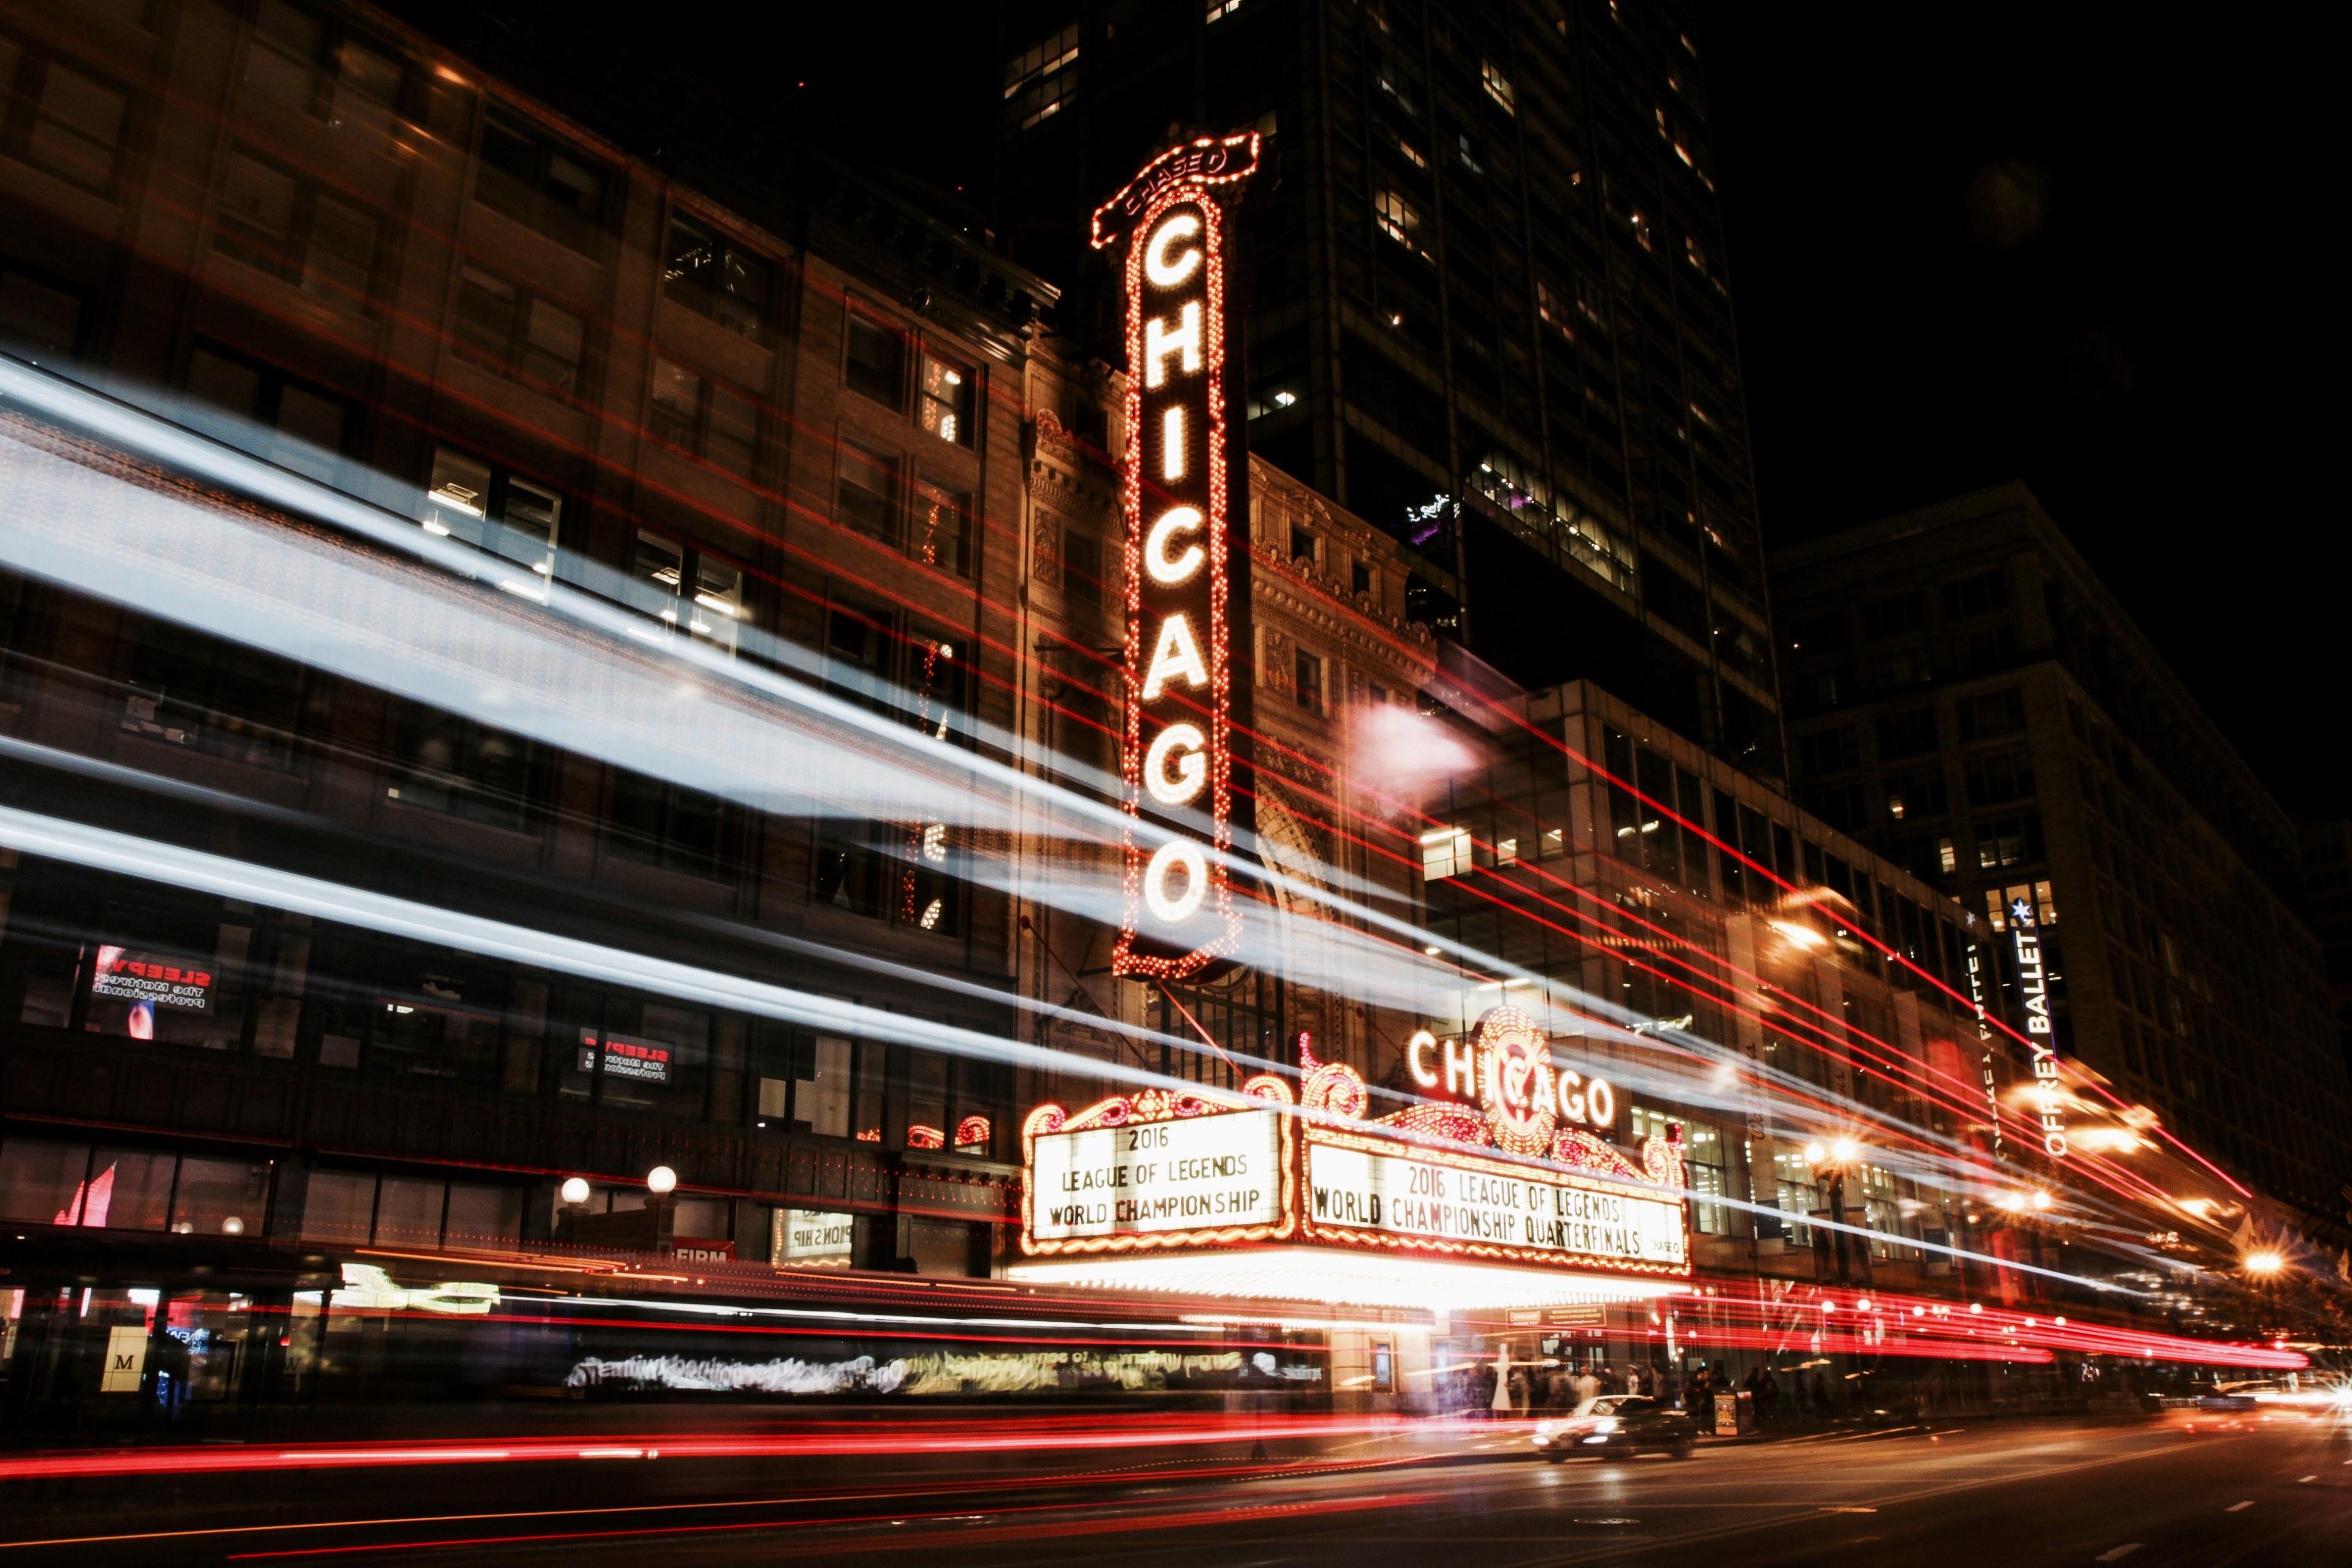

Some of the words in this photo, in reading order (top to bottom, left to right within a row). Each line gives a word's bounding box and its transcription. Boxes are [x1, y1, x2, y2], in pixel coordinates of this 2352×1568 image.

[1142, 214, 1210, 924] CHICAGO
[2015, 930, 2051, 1034] BALLET
[1409, 1030, 1614, 1126] CHICAGO
[1129, 1127, 1169, 1151] 2016
[1062, 1166, 1128, 1191] LEAGUE
[1136, 1163, 1158, 1185] OF
[1169, 1154, 1247, 1181] LEGENDS
[1409, 1166, 1446, 1198] 2016
[1460, 1174, 1520, 1209] LEAGUE
[1529, 1186, 1546, 1212] OF
[1556, 1189, 1619, 1223] LEGENDS
[1050, 1203, 1107, 1226] WORLD
[1116, 1189, 1260, 1223] CHAMPIONSHIP
[1314, 1186, 1381, 1224] WORLD
[1393, 1198, 1515, 1240] CHAMPIONSHIP
[1526, 1216, 1640, 1254] QUARTERFINALS
[115, 1355, 134, 1370] M
